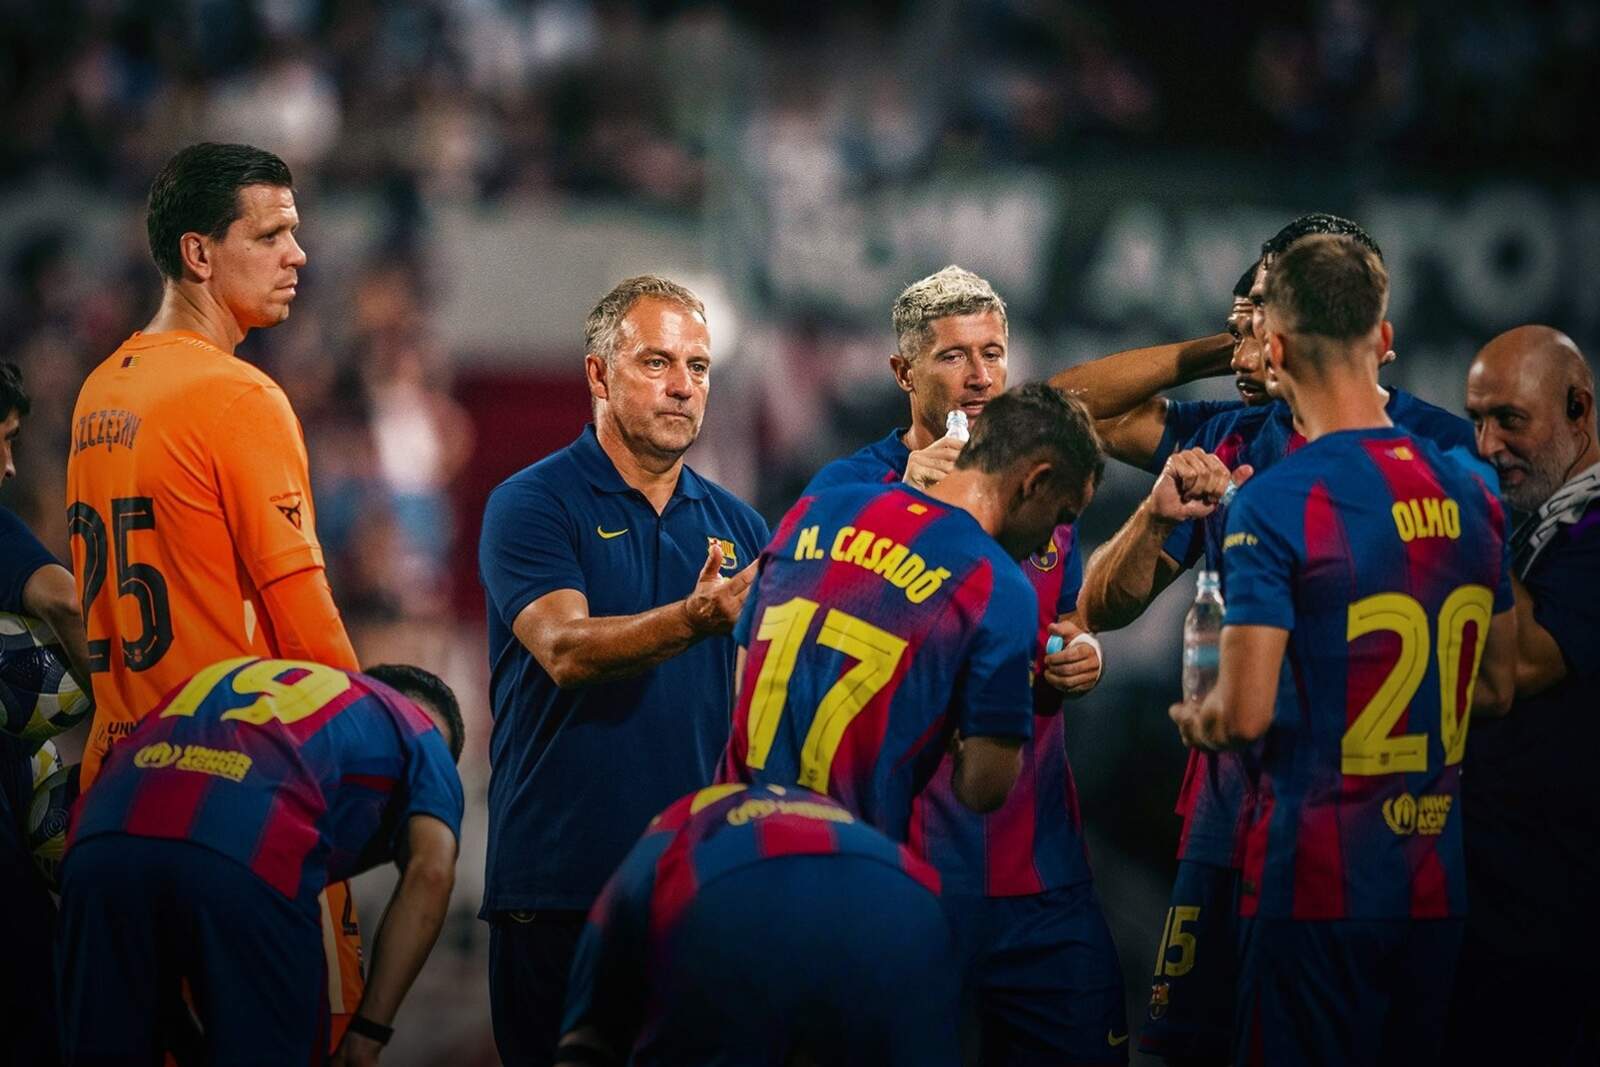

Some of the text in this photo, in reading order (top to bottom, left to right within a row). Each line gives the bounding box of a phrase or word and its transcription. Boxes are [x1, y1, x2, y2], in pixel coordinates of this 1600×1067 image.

[1391, 497, 1461, 542] OLMO
[66, 496, 173, 673] 25
[794, 525, 952, 604] M. CASADÓ
[160, 656, 351, 726] 19
[747, 597, 908, 795] 17
[1341, 585, 1493, 775] 20
[1153, 905, 1201, 977] 15
